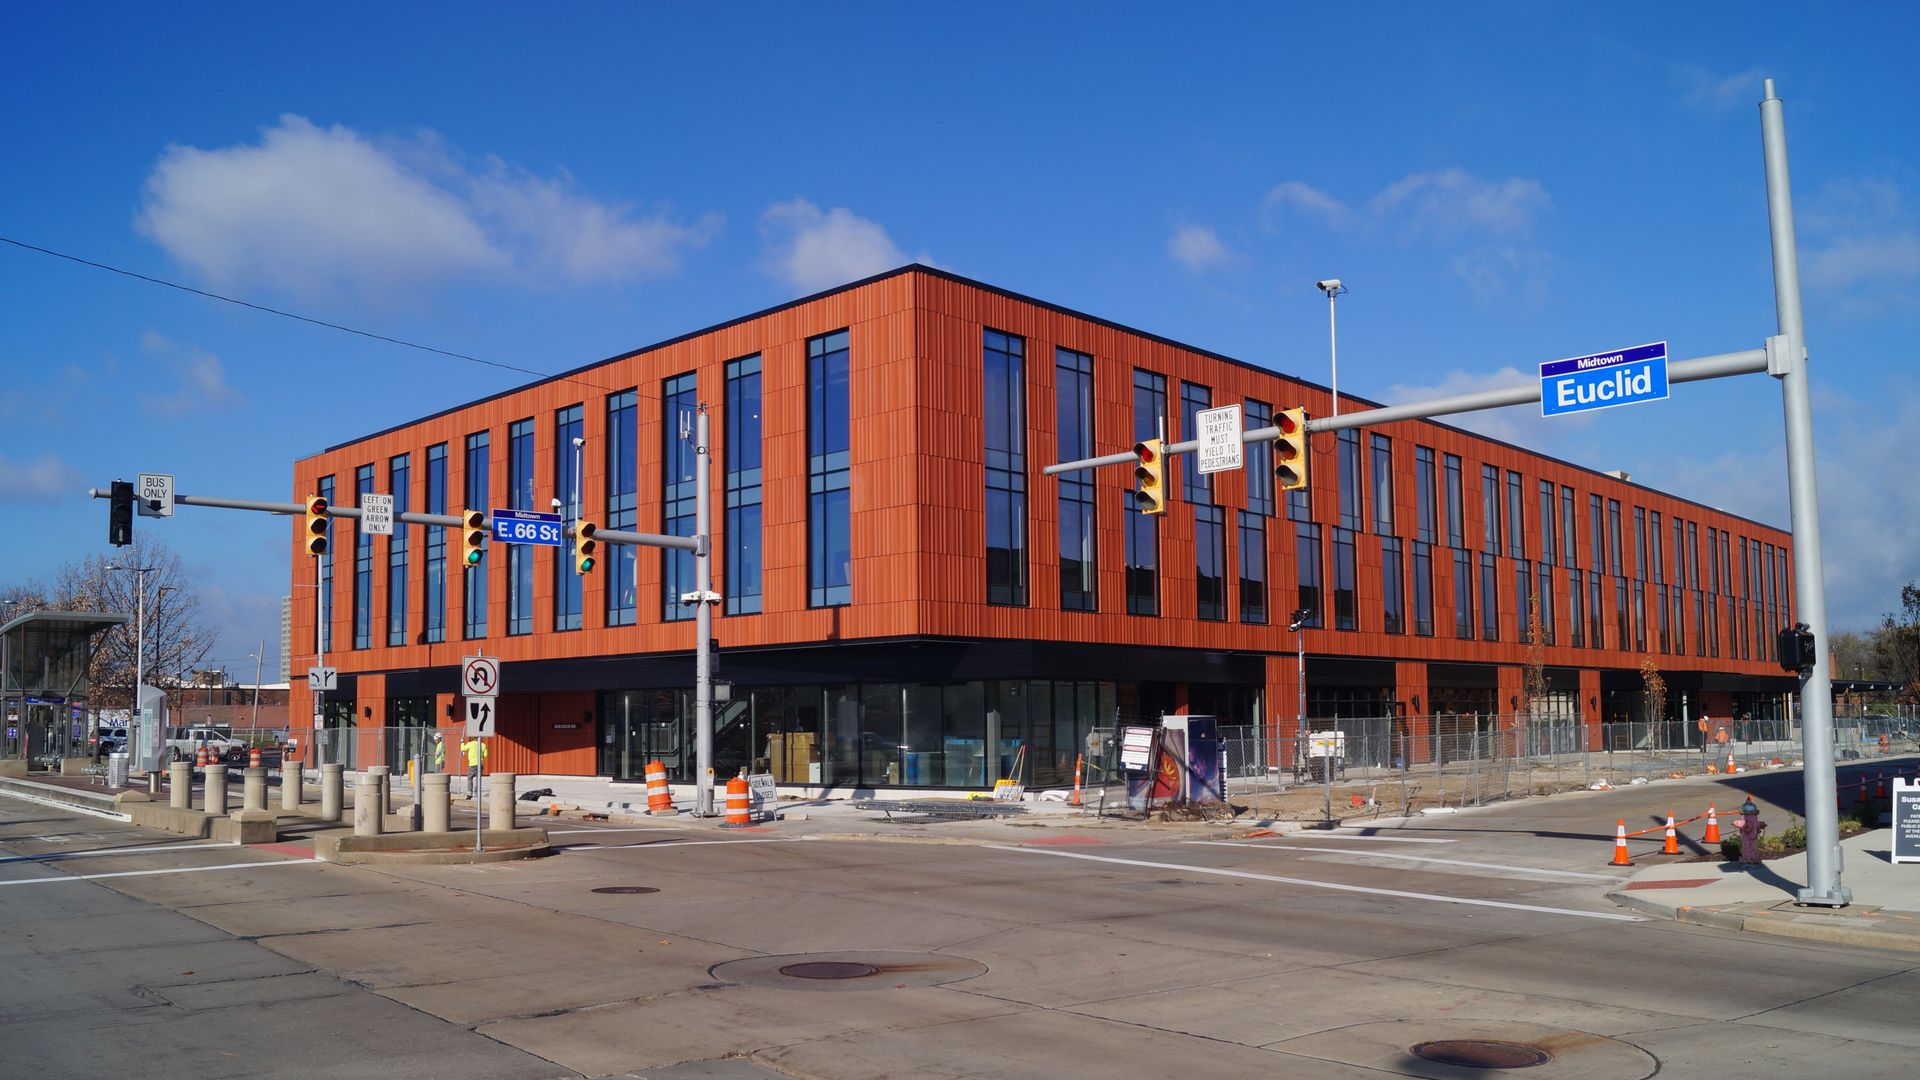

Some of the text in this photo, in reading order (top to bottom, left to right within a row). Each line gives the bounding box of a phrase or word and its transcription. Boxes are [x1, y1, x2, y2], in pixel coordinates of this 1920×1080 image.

[1577, 354, 1624, 369] Midtown
[1557, 365, 1652, 407] Euclid
[1205, 410, 1233, 424] TURNING
[1206, 422, 1233, 434] TRAFFIC
[1211, 434, 1228, 445] MUST
[1205, 444, 1236, 457] YIELD TO
[1201, 455, 1240, 469] PEDESTRIANS
[146, 477, 165, 487] BUS
[144, 488, 167, 498] ONLY
[363, 496, 379, 504] LEFT
[366, 514, 389, 522] ARROW
[369, 523, 386, 532] ONLY
[498, 521, 559, 541] E. 66 St
